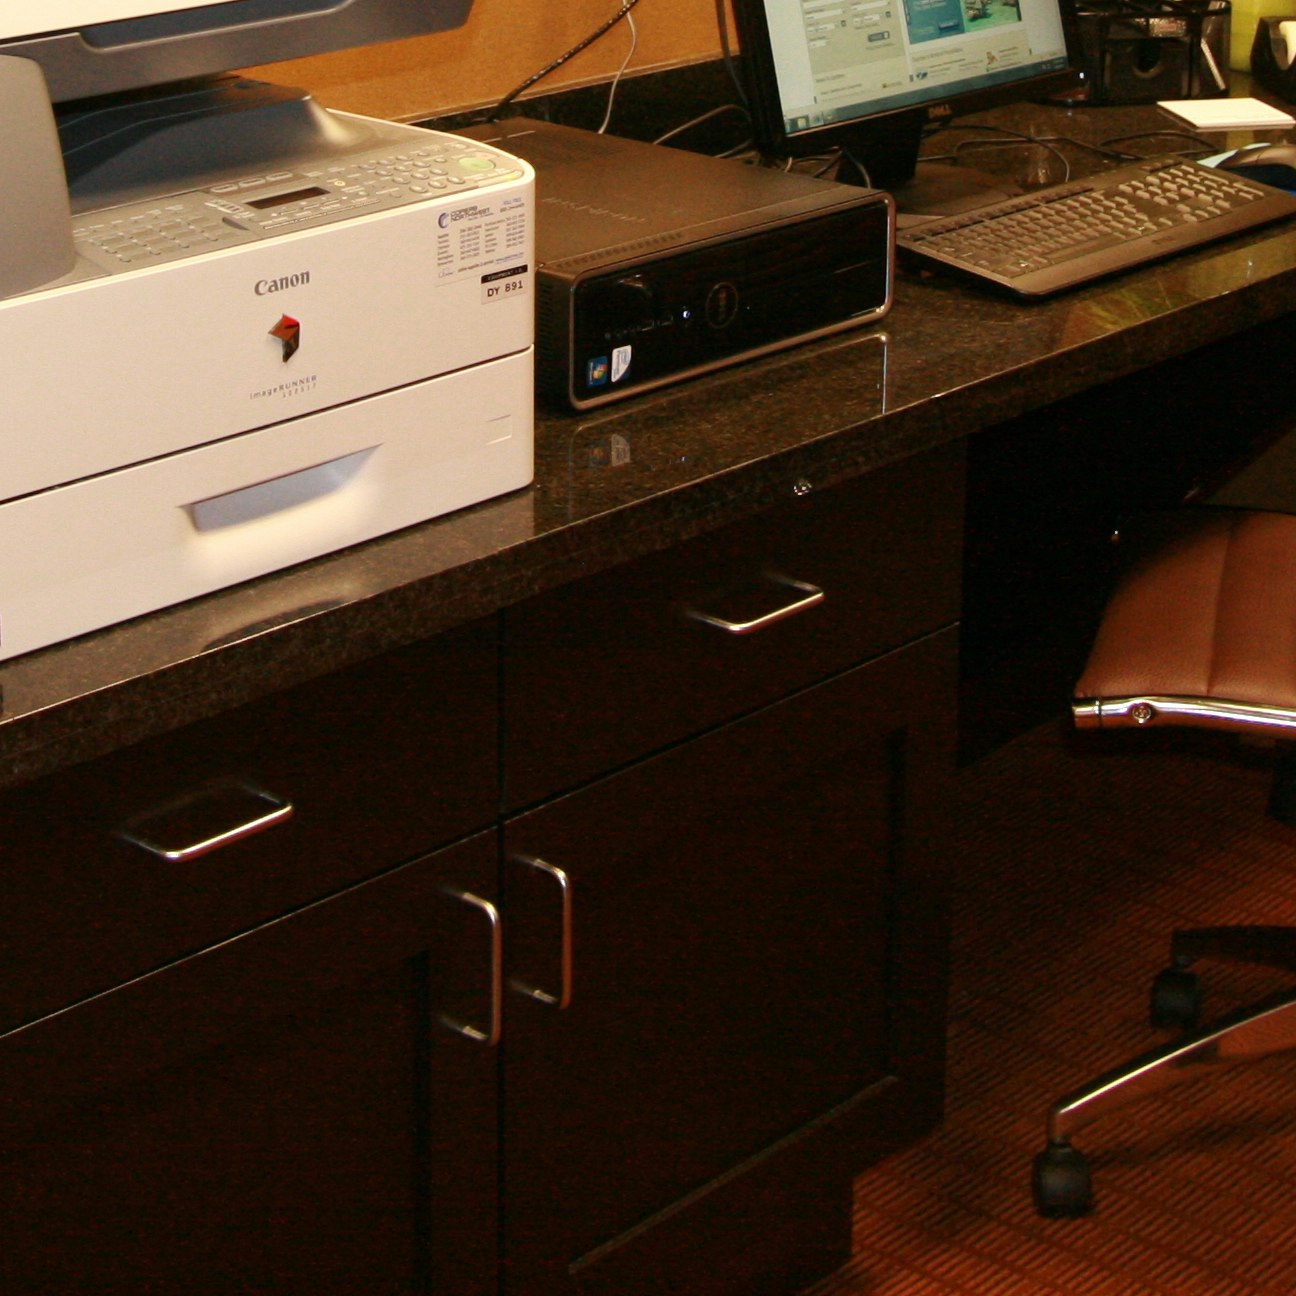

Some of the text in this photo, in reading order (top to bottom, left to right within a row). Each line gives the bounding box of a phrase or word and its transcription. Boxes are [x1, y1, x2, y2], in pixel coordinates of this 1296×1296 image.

[254, 270, 310, 296] Canon
[487, 280, 523, 297] DY 891
[249, 374, 317, 400] imageRUNNER
